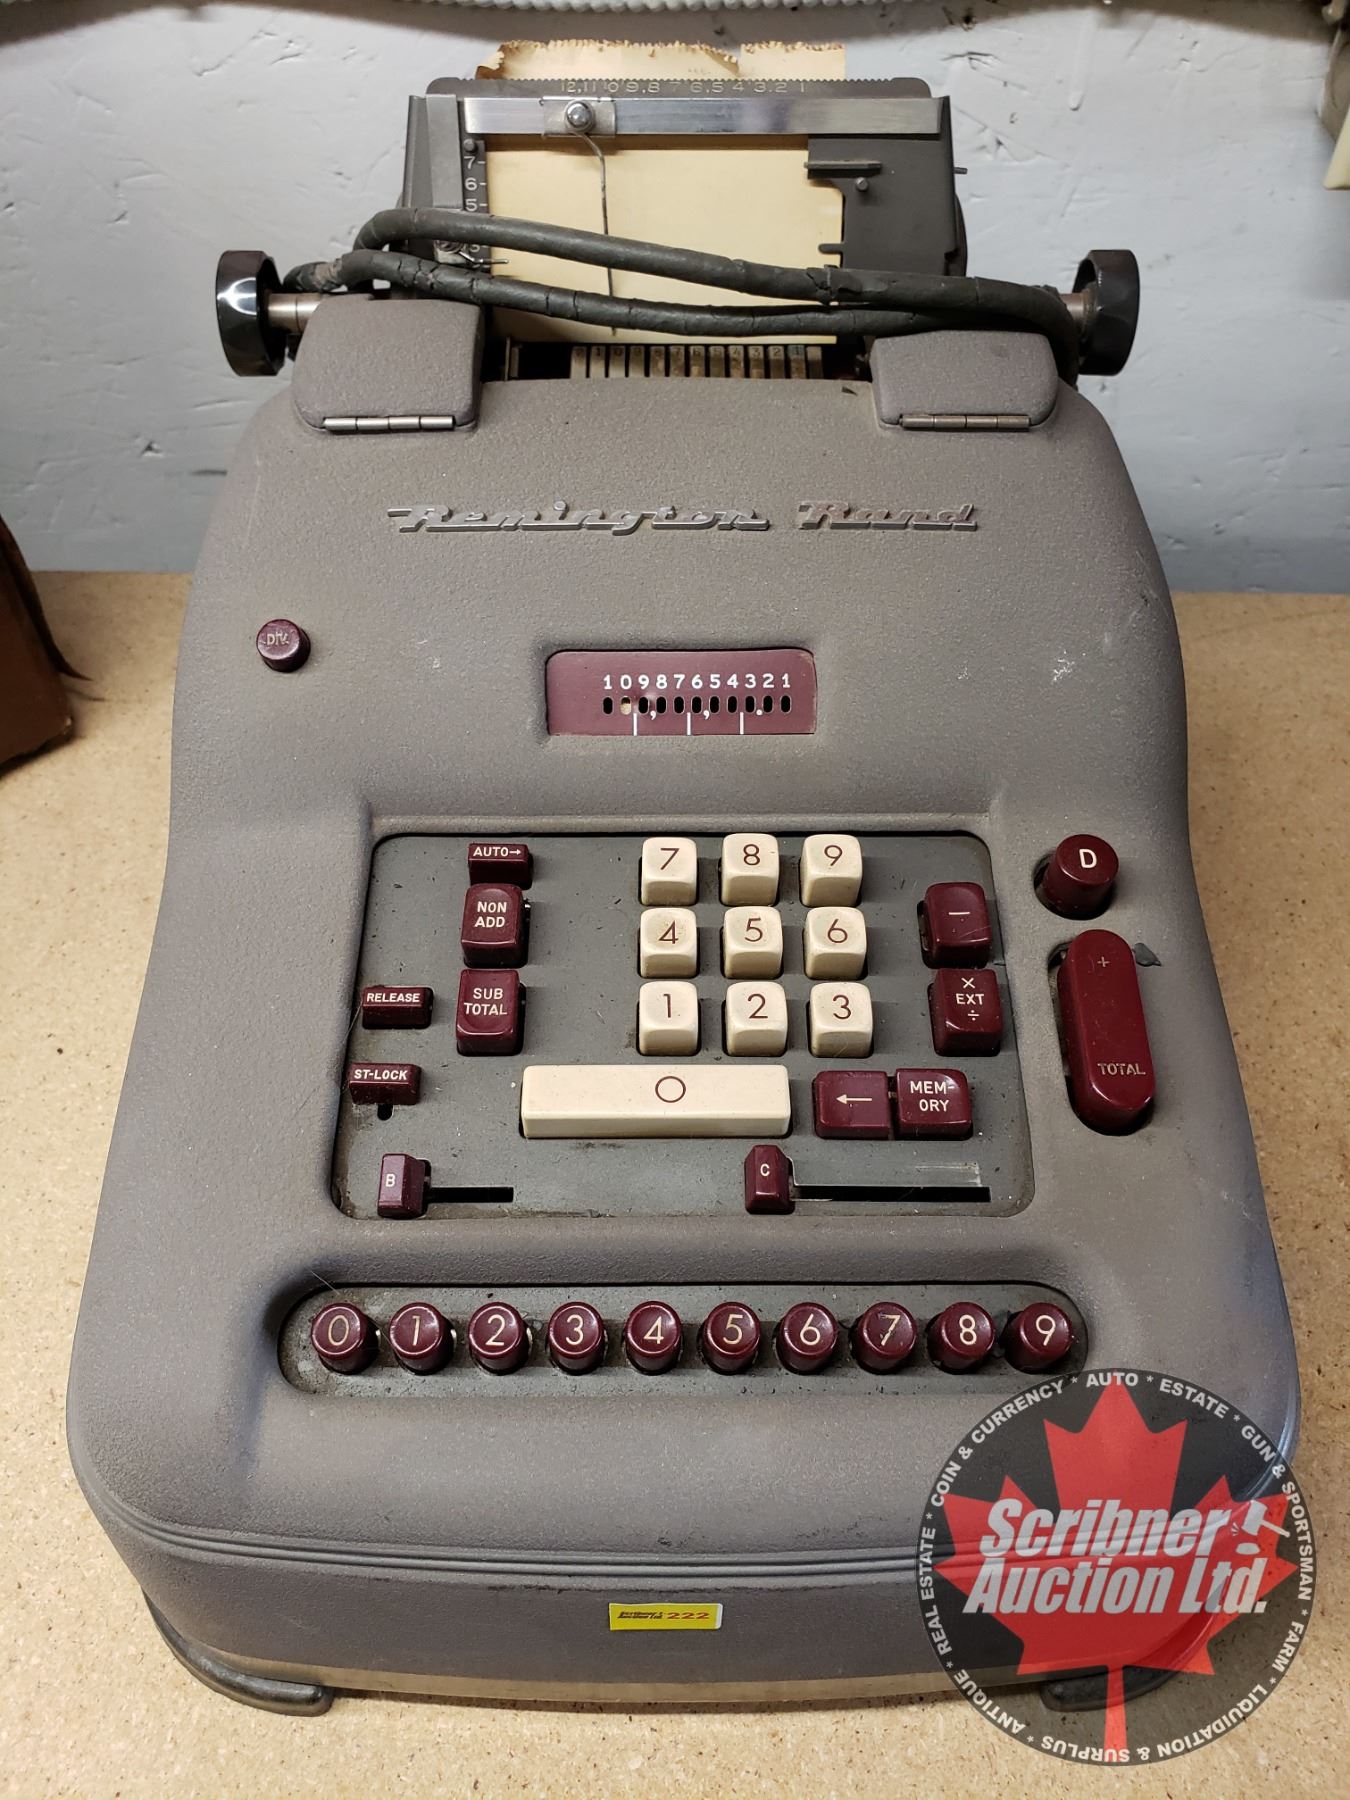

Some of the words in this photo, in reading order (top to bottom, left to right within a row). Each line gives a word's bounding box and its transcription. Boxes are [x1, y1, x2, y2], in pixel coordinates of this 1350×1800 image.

[464, 156, 475, 169] 7
[465, 177, 478, 190] 6
[465, 199, 478, 212] 5
[388, 502, 770, 536] Remington
[800, 502, 977, 531] Rand
[473, 846, 509, 857] AUTO
[743, 844, 760, 866] 8
[824, 845, 843, 866] 9
[660, 848, 679, 870] 7
[1079, 849, 1098, 869] D
[477, 901, 507, 914] NON
[475, 916, 506, 928] ADD
[660, 921, 679, 944] 4
[744, 918, 763, 942] 5
[827, 919, 848, 943] 6
[366, 992, 420, 1004] RELEASE
[473, 988, 503, 1000] SUB
[956, 993, 984, 1006] EXT
[464, 1003, 508, 1016] TOTAL
[663, 993, 672, 1018] 1
[747, 994, 768, 1019] 2
[832, 995, 852, 1019] 3
[354, 1069, 408, 1081] ST-LOCK
[1097, 1063, 1146, 1076] TOTAL
[919, 1099, 950, 1112] ORY
[760, 1164, 770, 1177] C
[385, 1174, 396, 1187] B
[328, 1315, 350, 1346] 0
[411, 1316, 421, 1346] 1
[485, 1314, 506, 1346] 2
[565, 1315, 585, 1345] 3
[644, 1316, 665, 1345] 4
[722, 1315, 743, 1345] 5
[800, 1313, 821, 1345] 6
[878, 1314, 901, 1346] 7
[959, 1315, 977, 1345] 8
[1035, 1315, 1056, 1346] 9
[667, 1612, 710, 1620] 222
